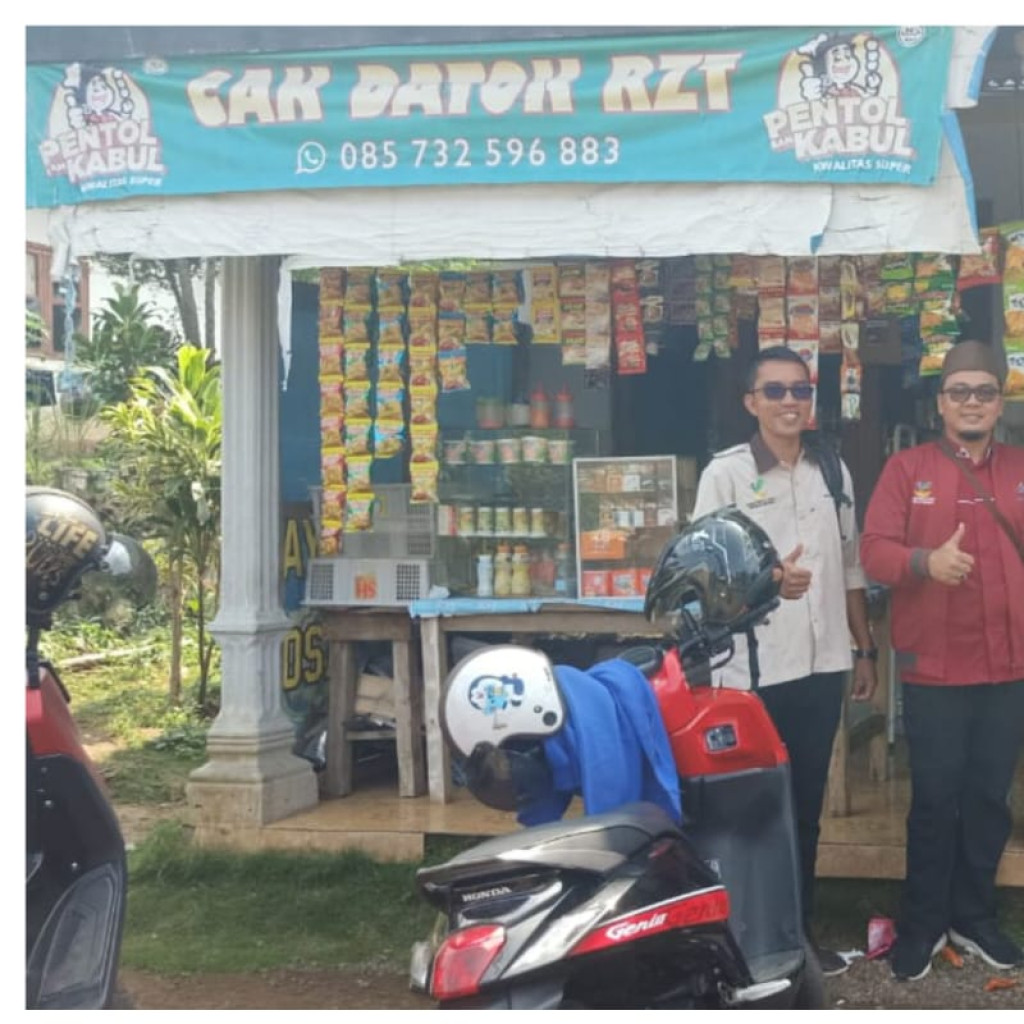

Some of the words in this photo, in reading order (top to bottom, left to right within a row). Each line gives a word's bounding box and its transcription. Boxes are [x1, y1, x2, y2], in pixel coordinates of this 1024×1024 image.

[187, 64, 331, 127] CAK
[349, 57, 582, 118] DATOK
[602, 53, 745, 112] RZT
[763, 96, 907, 139] PENTOL
[38, 119, 158, 168] PENTOL
[340, 140, 398, 170] 085
[411, 138, 472, 169] 732
[485, 137, 546, 167] 596
[559, 136, 620, 165] 883
[795, 125, 914, 160] KABUL
[67, 145, 164, 183] KABUL
[875, 159, 912, 174] SUPER
[462, 886, 512, 902] HONDA
